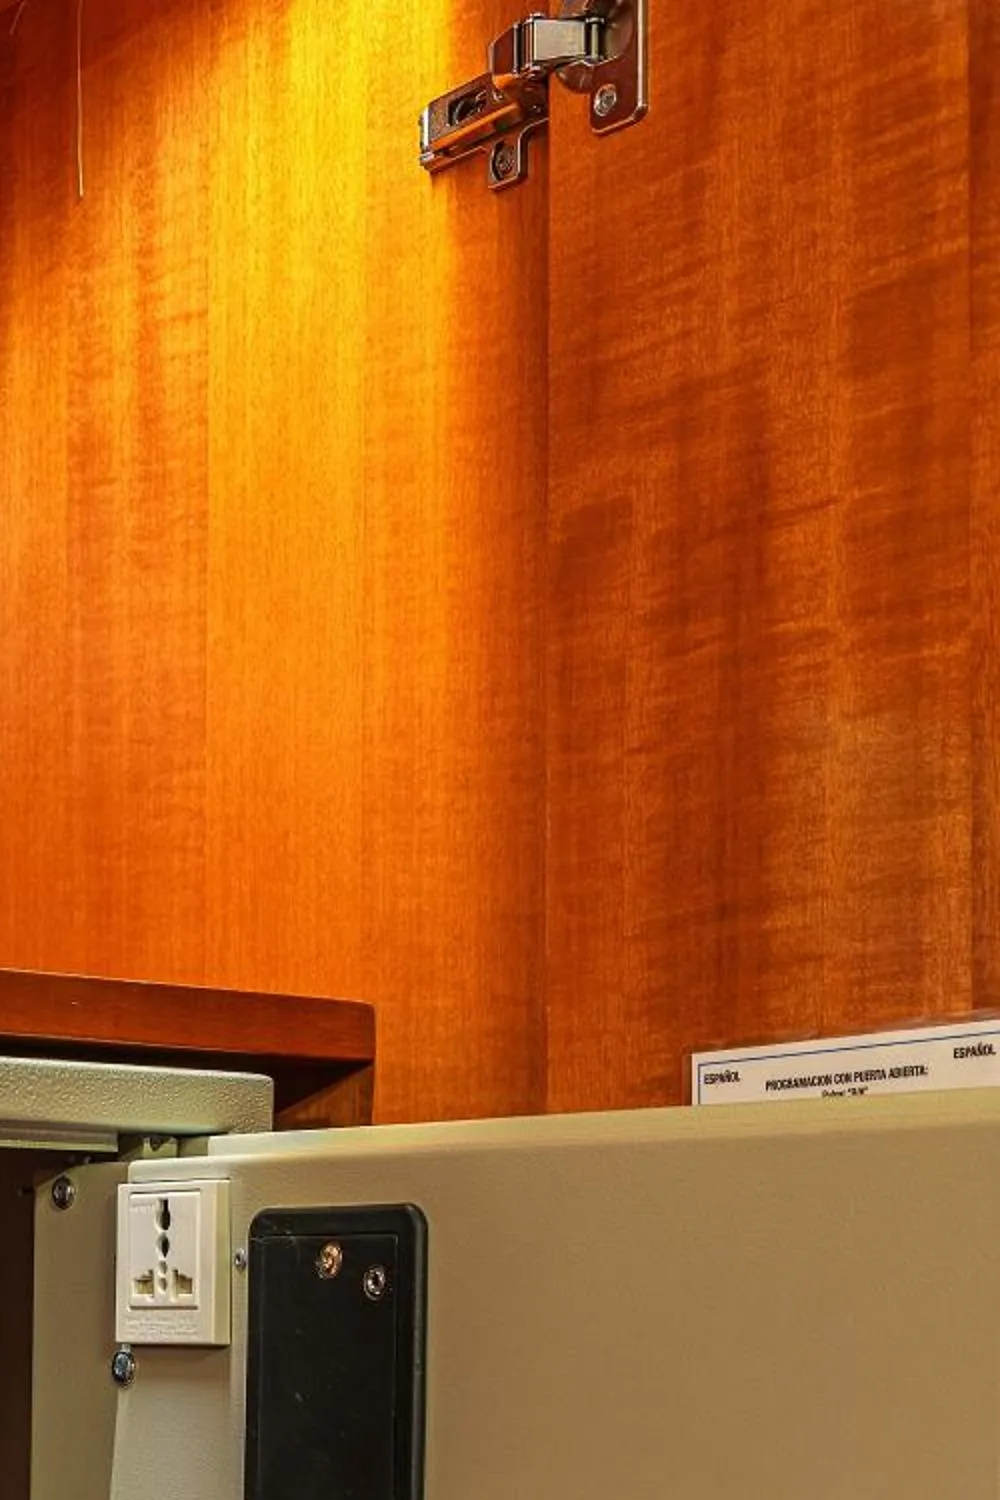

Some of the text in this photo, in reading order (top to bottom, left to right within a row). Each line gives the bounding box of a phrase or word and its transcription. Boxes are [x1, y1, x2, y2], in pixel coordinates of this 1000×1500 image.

[953, 1042, 997, 1059] ESPAÑOL
[703, 1069, 741, 1085] ESPAÑOL
[765, 1073, 833, 1092] PROGRAMACION
[833, 1072, 852, 1085] CON
[853, 1069, 887, 1083] PUERTA
[888, 1065, 929, 1079] ABIERTA:
